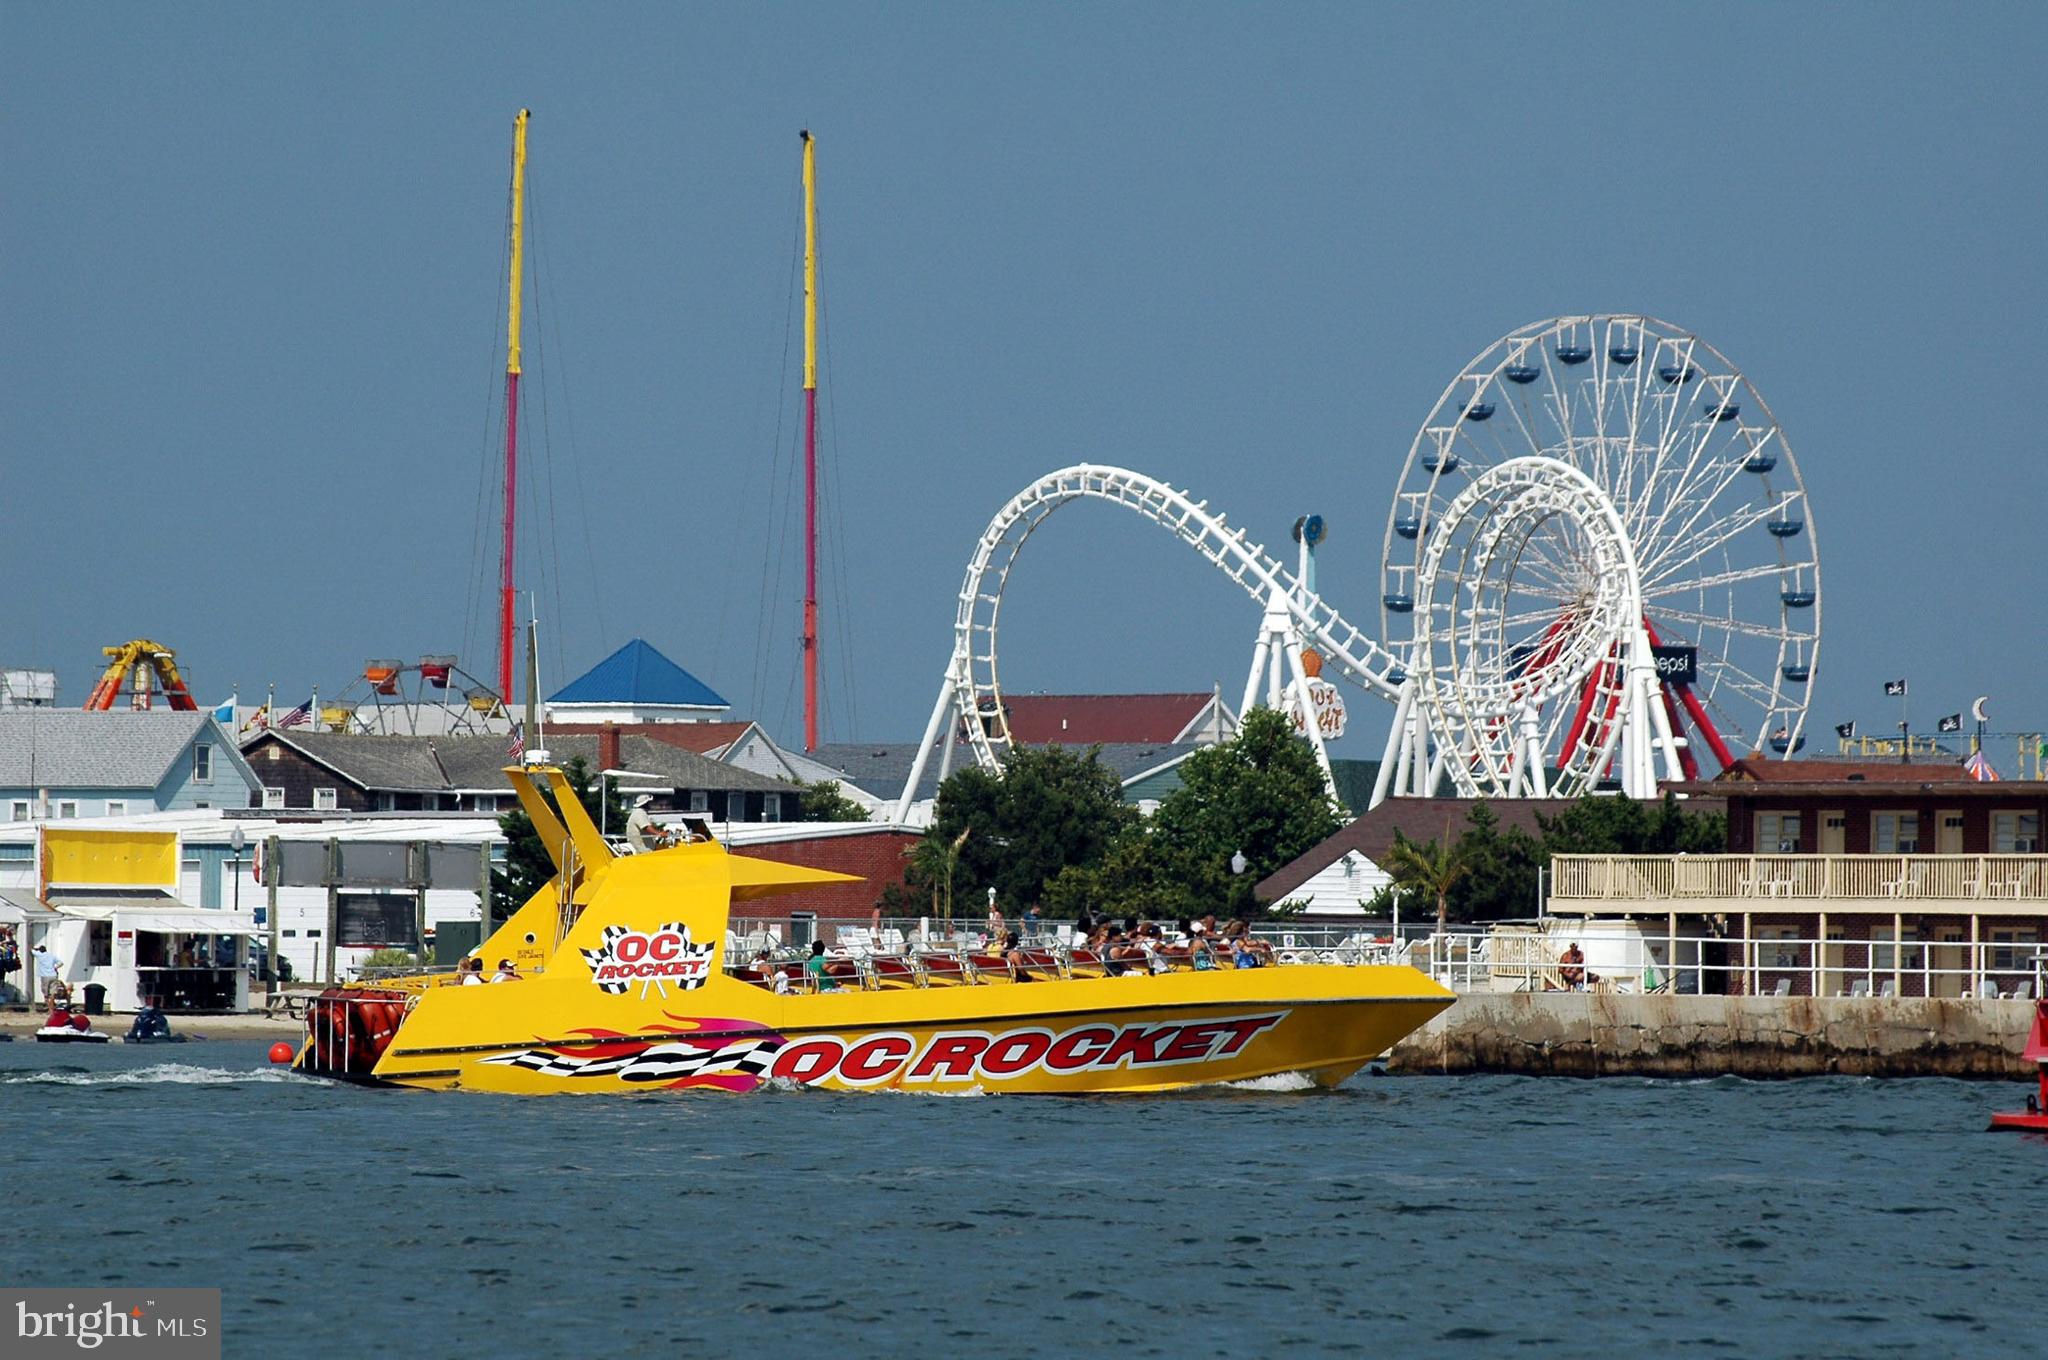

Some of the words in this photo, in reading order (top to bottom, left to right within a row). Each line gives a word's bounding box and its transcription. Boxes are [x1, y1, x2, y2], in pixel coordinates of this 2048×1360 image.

[299, 907, 305, 918] 5
[616, 933, 681, 962] OC
[597, 960, 706, 979] ROCKET
[769, 1036, 913, 1084] OC
[908, 1013, 1284, 1077] ROCKET
